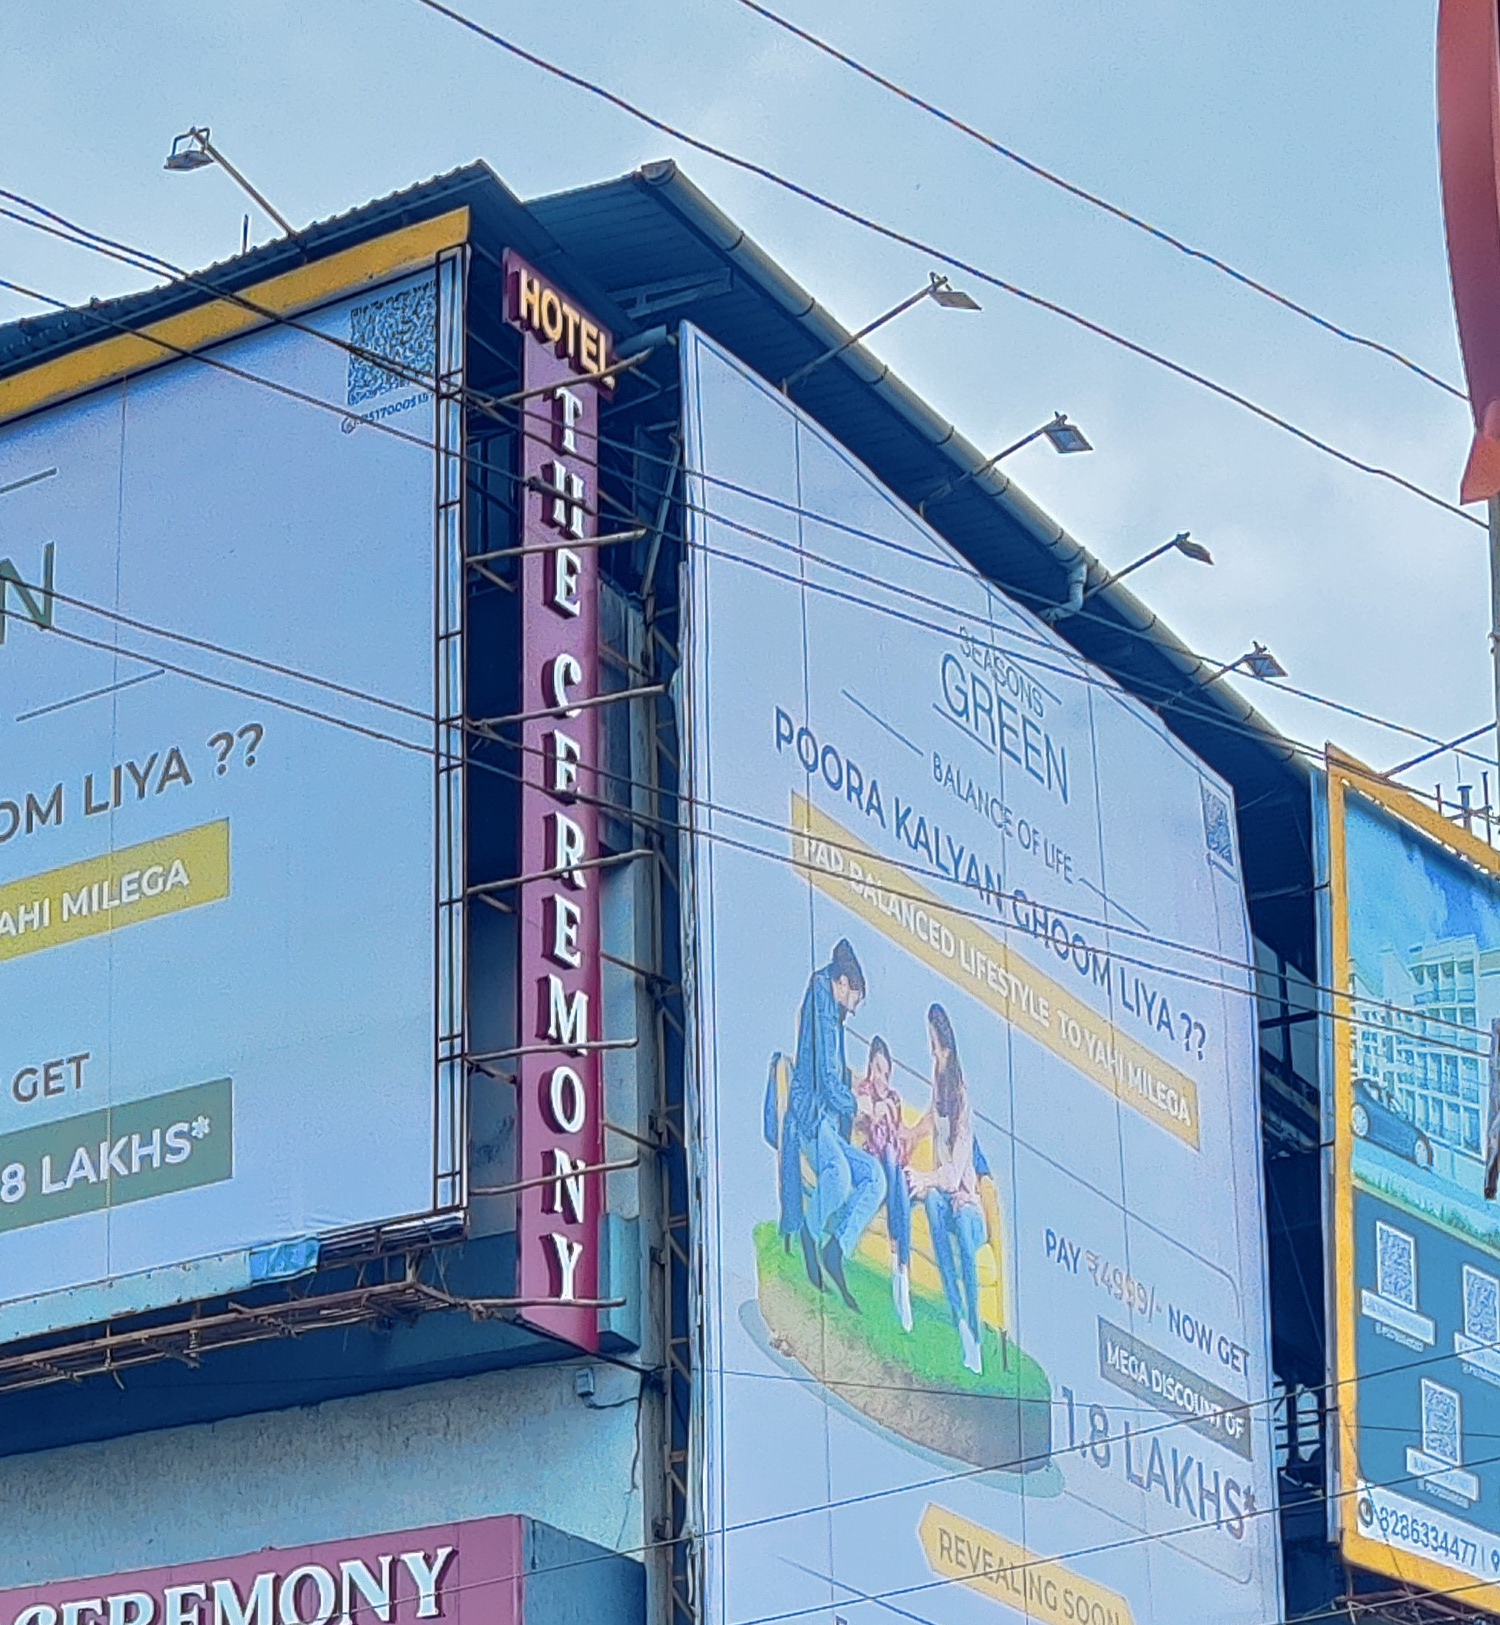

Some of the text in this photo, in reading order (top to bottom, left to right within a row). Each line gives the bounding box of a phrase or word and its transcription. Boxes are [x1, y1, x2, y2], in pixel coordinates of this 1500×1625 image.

[519, 267, 616, 390] HOTEL
[550, 386, 585, 618] THE
[959, 625, 1045, 719] SEASONS
[84, 745, 194, 817] LIYA
[206, 722, 265, 776] ??
[942, 652, 1069, 805] GREEN
[933, 751, 1073, 884] BALANCE OF LIFE
[61, 858, 190, 923] MILEGA
[775, 705, 1208, 1062] POORA KALYAN GHOOM LIYA ??
[547, 652, 590, 1301] CEREMONY
[849, 859, 956, 958] BALANCED
[960, 940, 1050, 1029] LIFESTYLE
[1057, 1010, 1081, 1050] TO
[1084, 1030, 1125, 1082] YAHI
[1128, 1063, 1192, 1127] MILEGA
[12, 1052, 91, 1100] GET
[1046, 1228, 1080, 1279] PAY
[1168, 1303, 1213, 1356] NOW
[1217, 1335, 1250, 1376] GET
[1062, 1385, 1111, 1469] 1.8
[1106, 1341, 1246, 1440] MEGA DISCOUNT OF
[938, 1527, 1058, 1612] REVEALING
[1380, 1506, 1477, 1567] 8286334477
